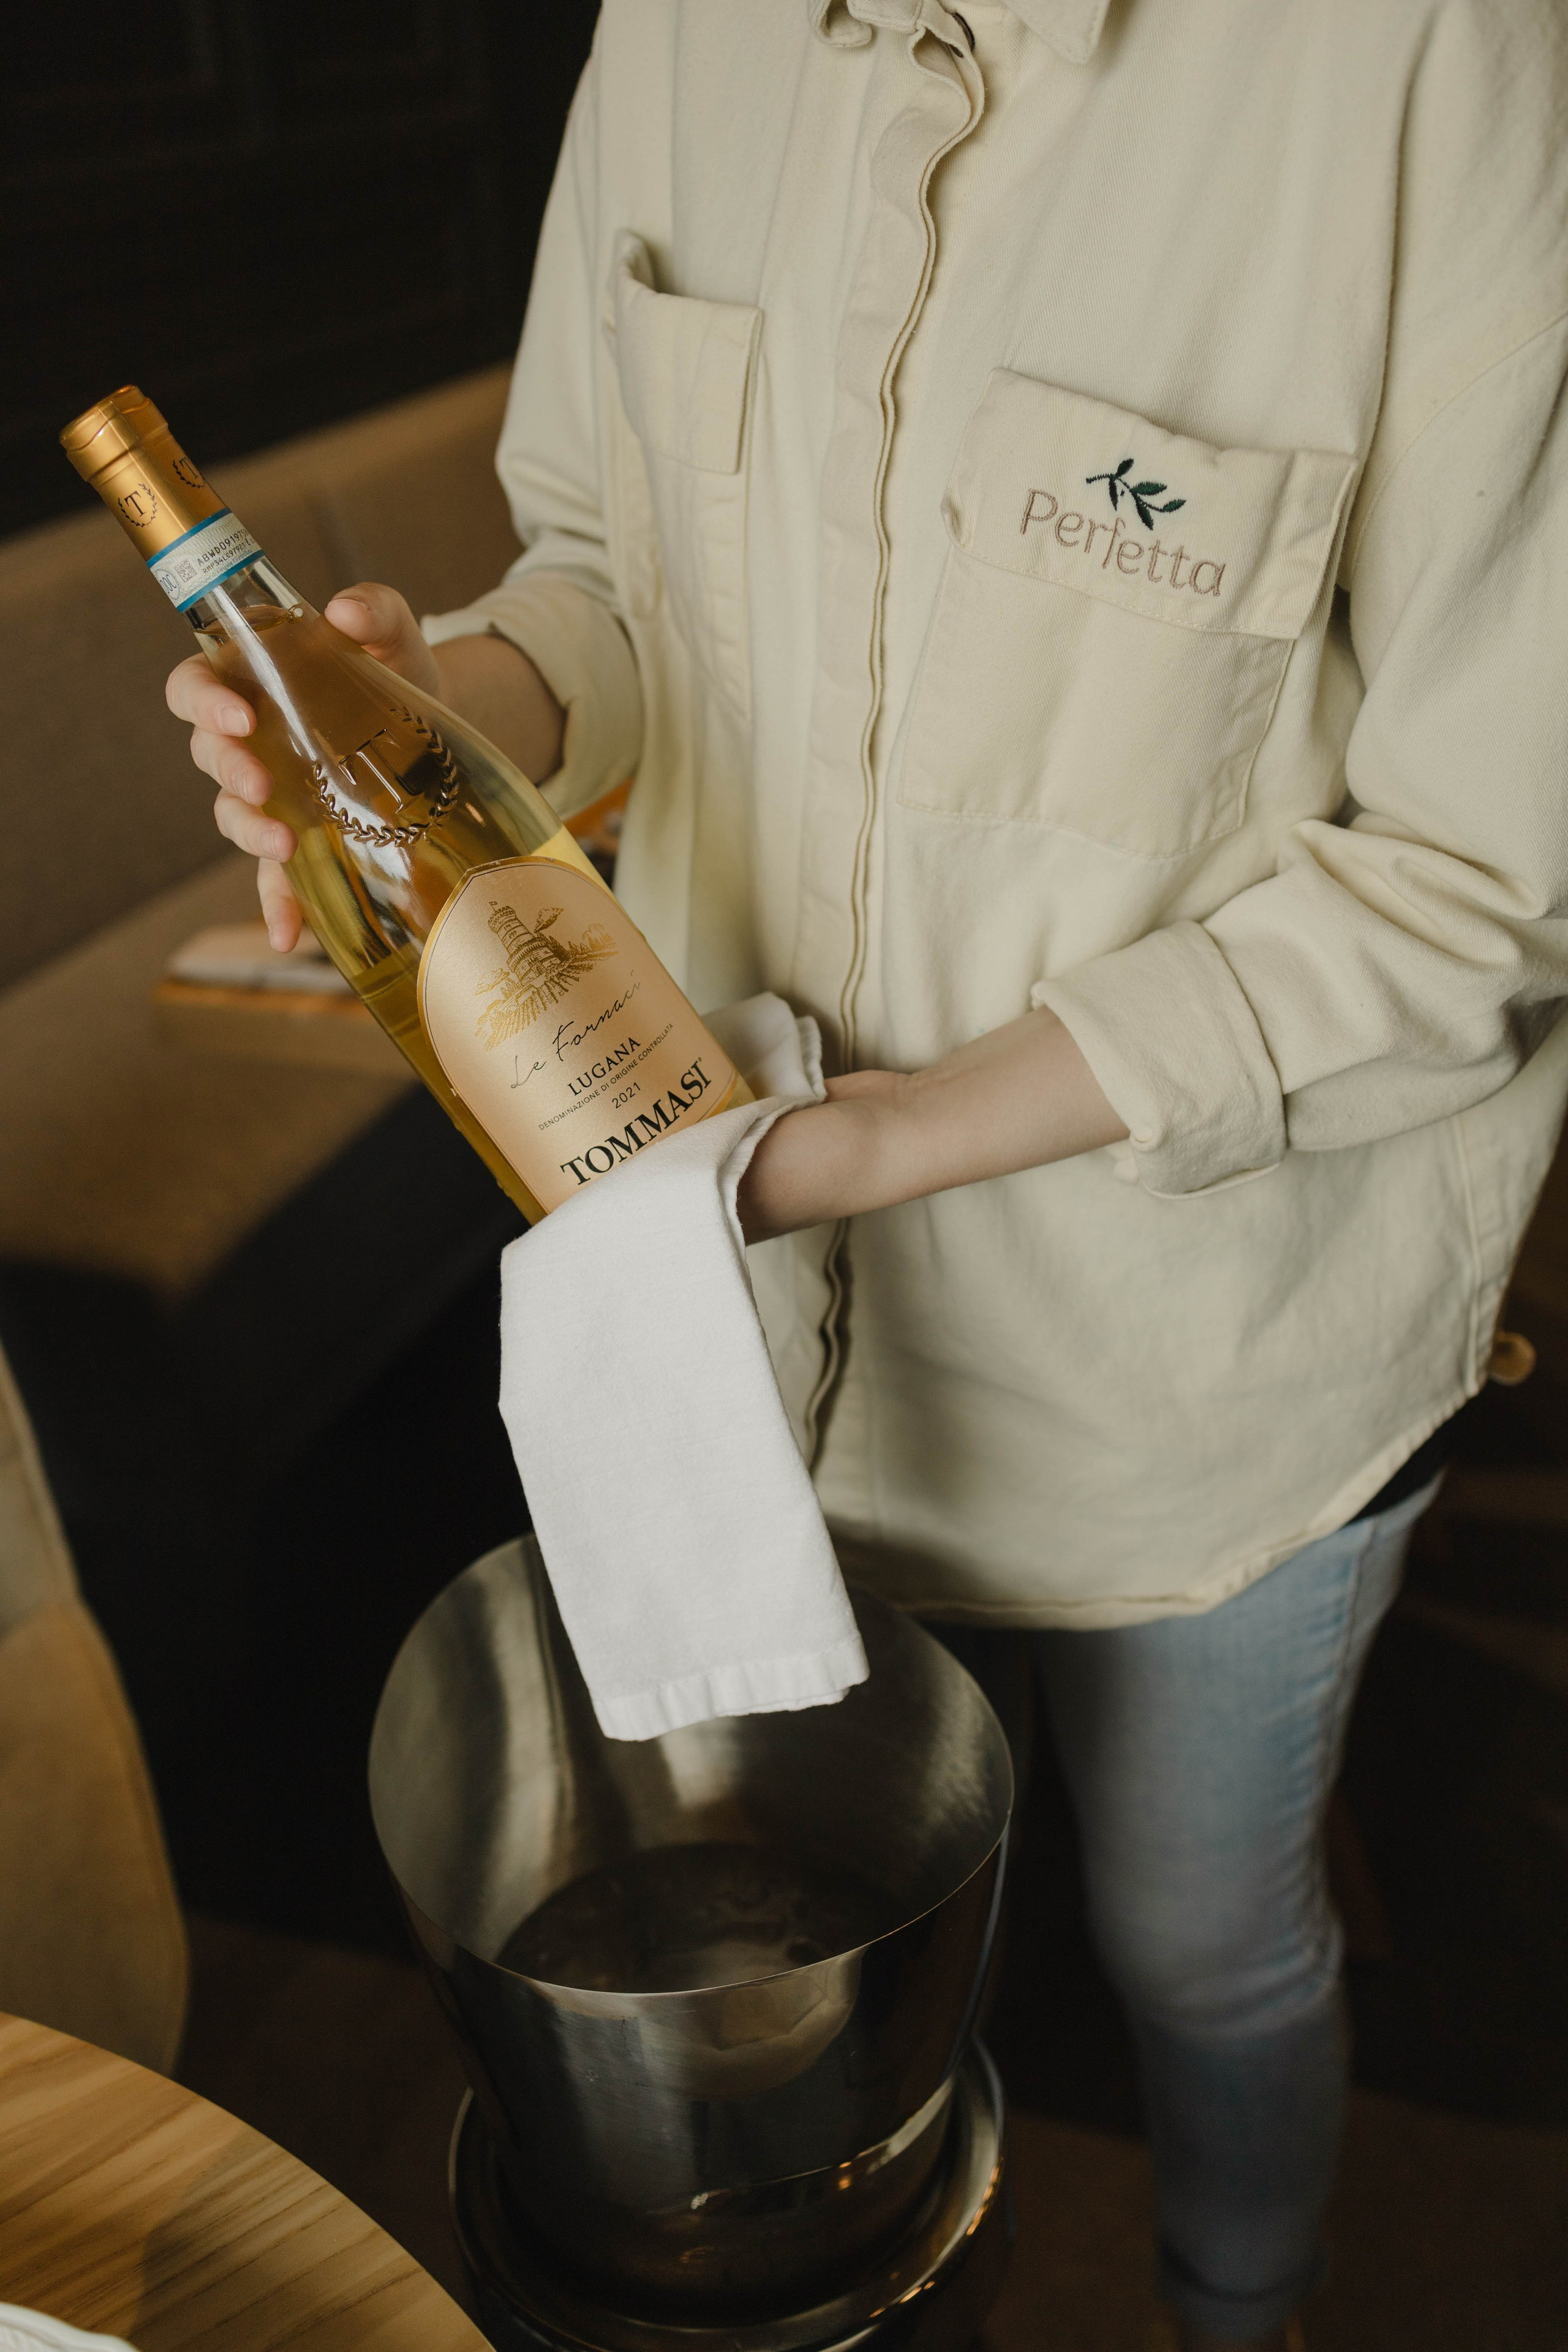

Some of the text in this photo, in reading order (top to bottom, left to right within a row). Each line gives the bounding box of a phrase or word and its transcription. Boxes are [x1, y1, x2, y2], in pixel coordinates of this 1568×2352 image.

[124, 490, 146, 518] T
[1019, 488, 1226, 597] Perfetta
[510, 970, 640, 1089] Le Fornaci
[538, 1023, 674, 1131] DENOMINAZIONE DI ORIGINE CONTROLLATA
[567, 1037, 641, 1096] LUGANA
[560, 1060, 712, 1185] TOMMASI
[612, 1082, 641, 1109] 2021
